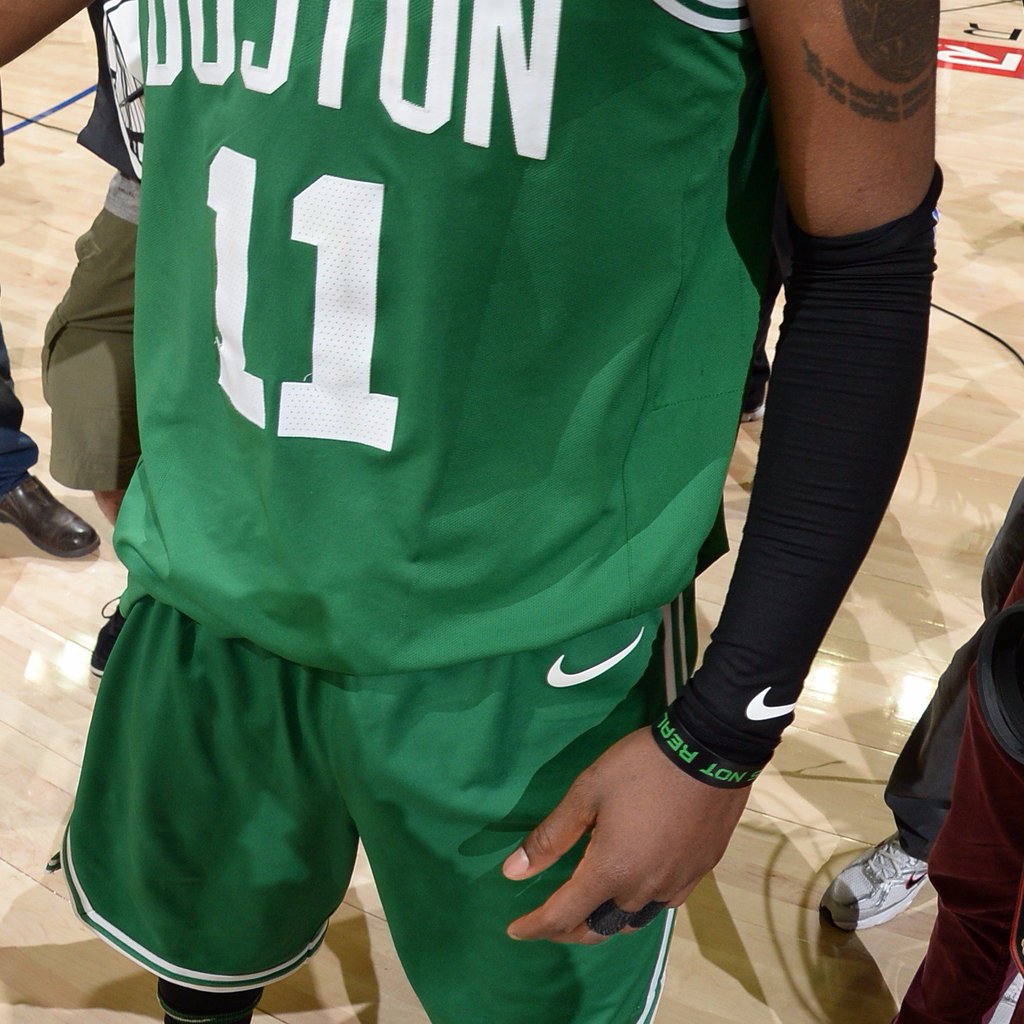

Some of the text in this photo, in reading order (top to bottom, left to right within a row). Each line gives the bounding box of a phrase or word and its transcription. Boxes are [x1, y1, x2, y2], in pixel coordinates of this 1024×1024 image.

[206, 145, 399, 452] 11
[657, 712, 699, 763] REAL
[699, 763, 747, 783] NOT
